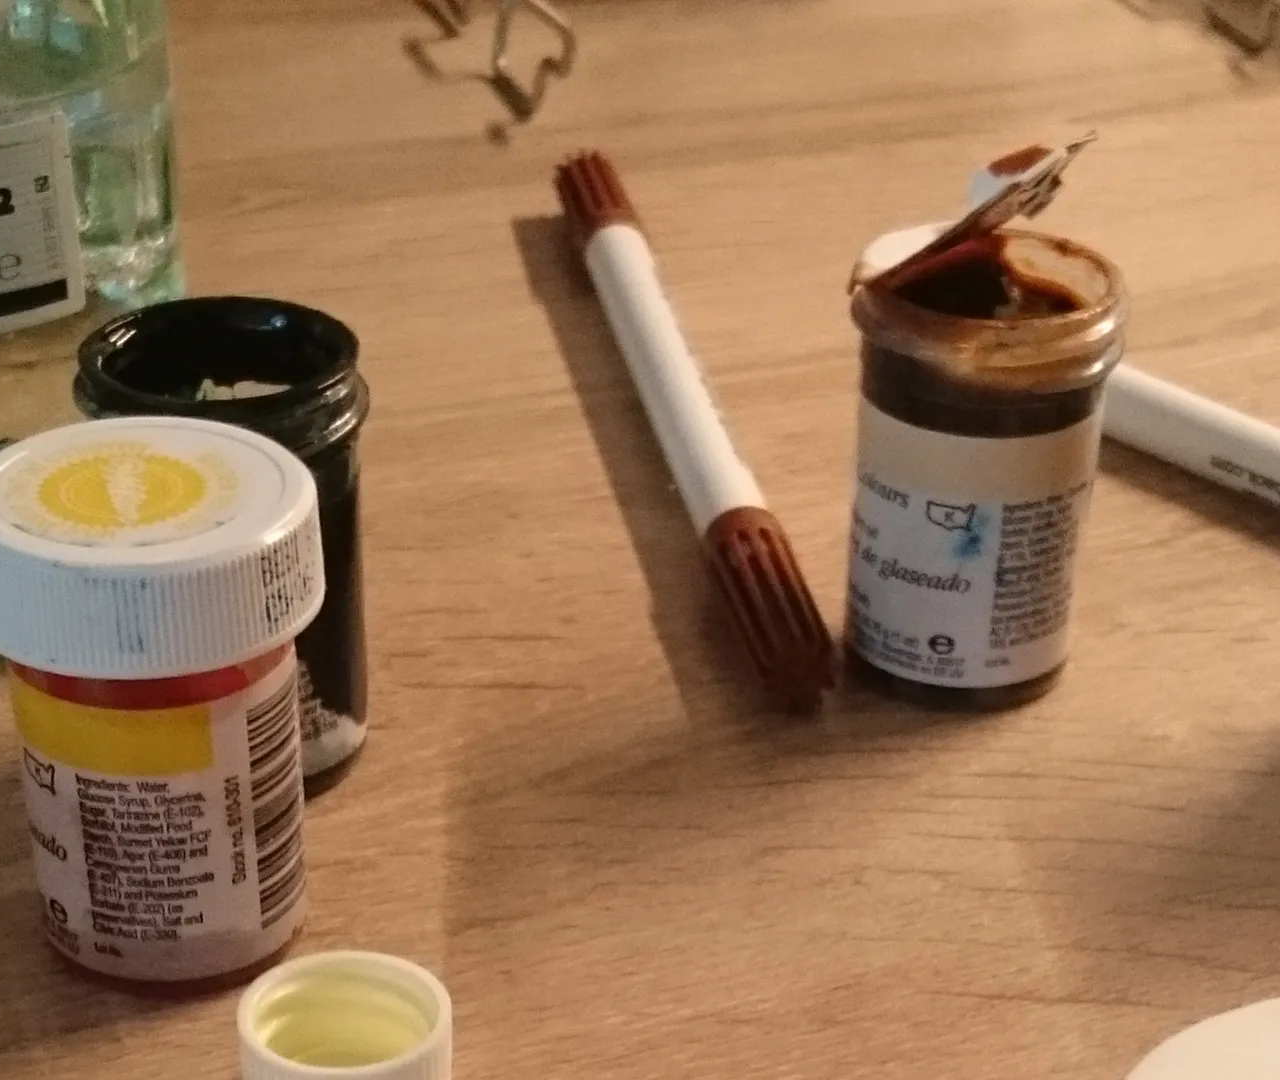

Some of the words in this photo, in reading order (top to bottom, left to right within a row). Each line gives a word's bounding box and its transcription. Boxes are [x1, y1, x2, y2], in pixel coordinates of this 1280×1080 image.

[877, 558, 972, 596] glaseado
[188, 844, 208, 859] and
[123, 889, 143, 901] and
[183, 910, 204, 925] and
